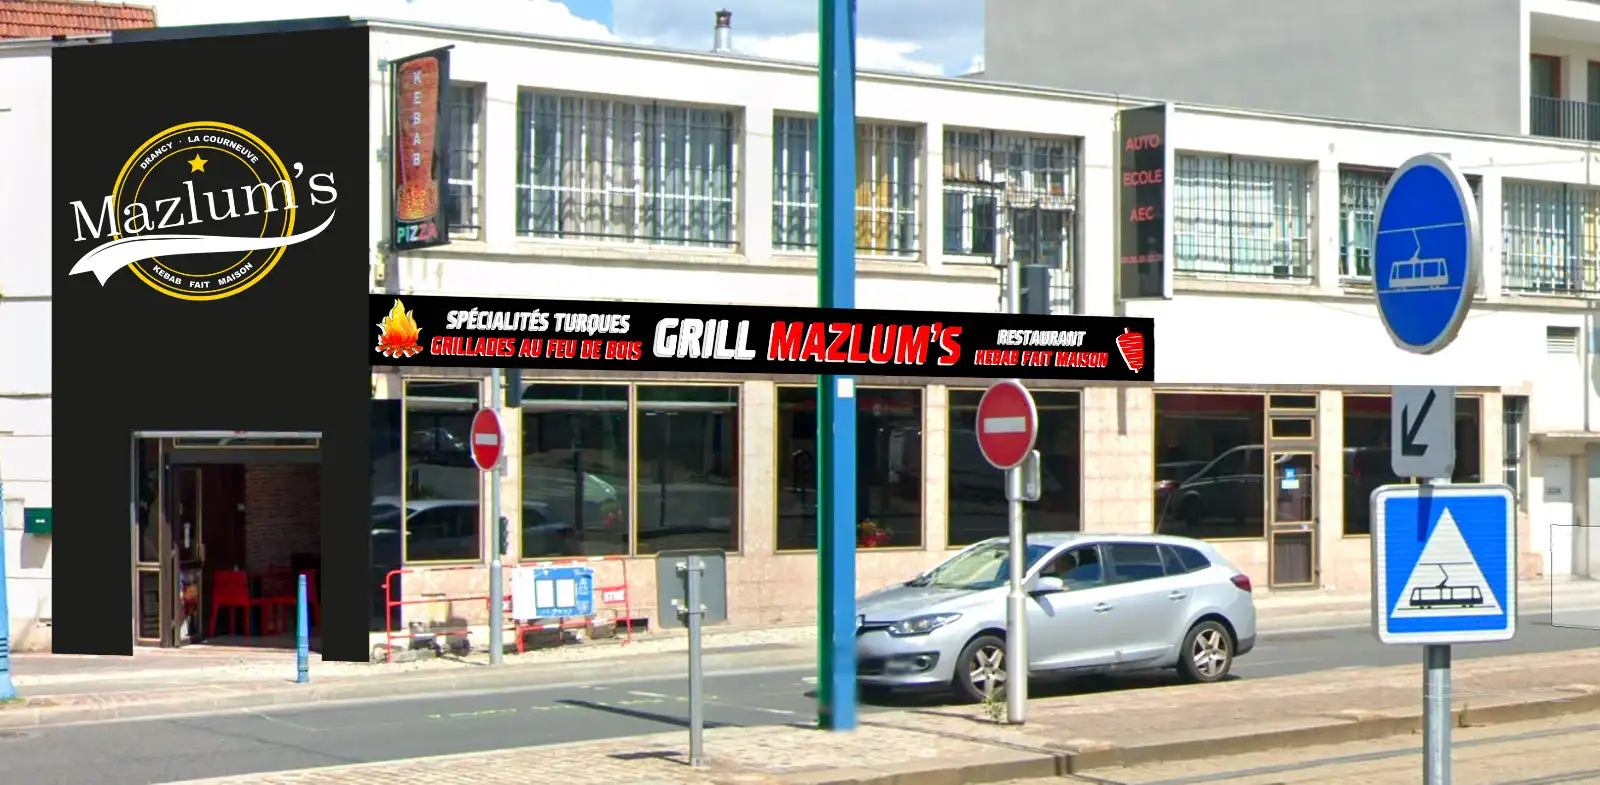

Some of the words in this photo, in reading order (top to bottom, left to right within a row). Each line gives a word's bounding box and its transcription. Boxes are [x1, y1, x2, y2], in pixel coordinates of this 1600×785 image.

[413, 71, 422, 168] KEBAB
[140, 141, 173, 170] DRANCY
[187, 135, 201, 144] LA
[203, 134, 259, 164] COURNEUVE
[1125, 134, 1161, 152] AUTO
[1123, 168, 1163, 186] ECOLE
[69, 161, 338, 242] Mazlum's
[1129, 206, 1155, 222] AEC
[397, 222, 438, 244] PIZZA
[152, 264, 182, 285] KEBAB
[189, 280, 211, 289] FAIT
[217, 261, 254, 286] MAISON
[446, 307, 550, 332] SPÉCIALITÉS
[554, 313, 631, 337] TURQUES
[430, 335, 516, 358] GRILLADES
[518, 338, 544, 358] AU
[546, 339, 579, 360] FEU
[580, 340, 604, 360] DE
[605, 340, 643, 361] BOIS
[653, 317, 756, 360] GRILL
[767, 320, 963, 366] MAZLUM'S
[996, 329, 1087, 347] RESTAURANT
[974, 349, 1020, 366] KEBAB
[1021, 351, 1054, 367] FAIT
[1055, 351, 1109, 368] MAISON
